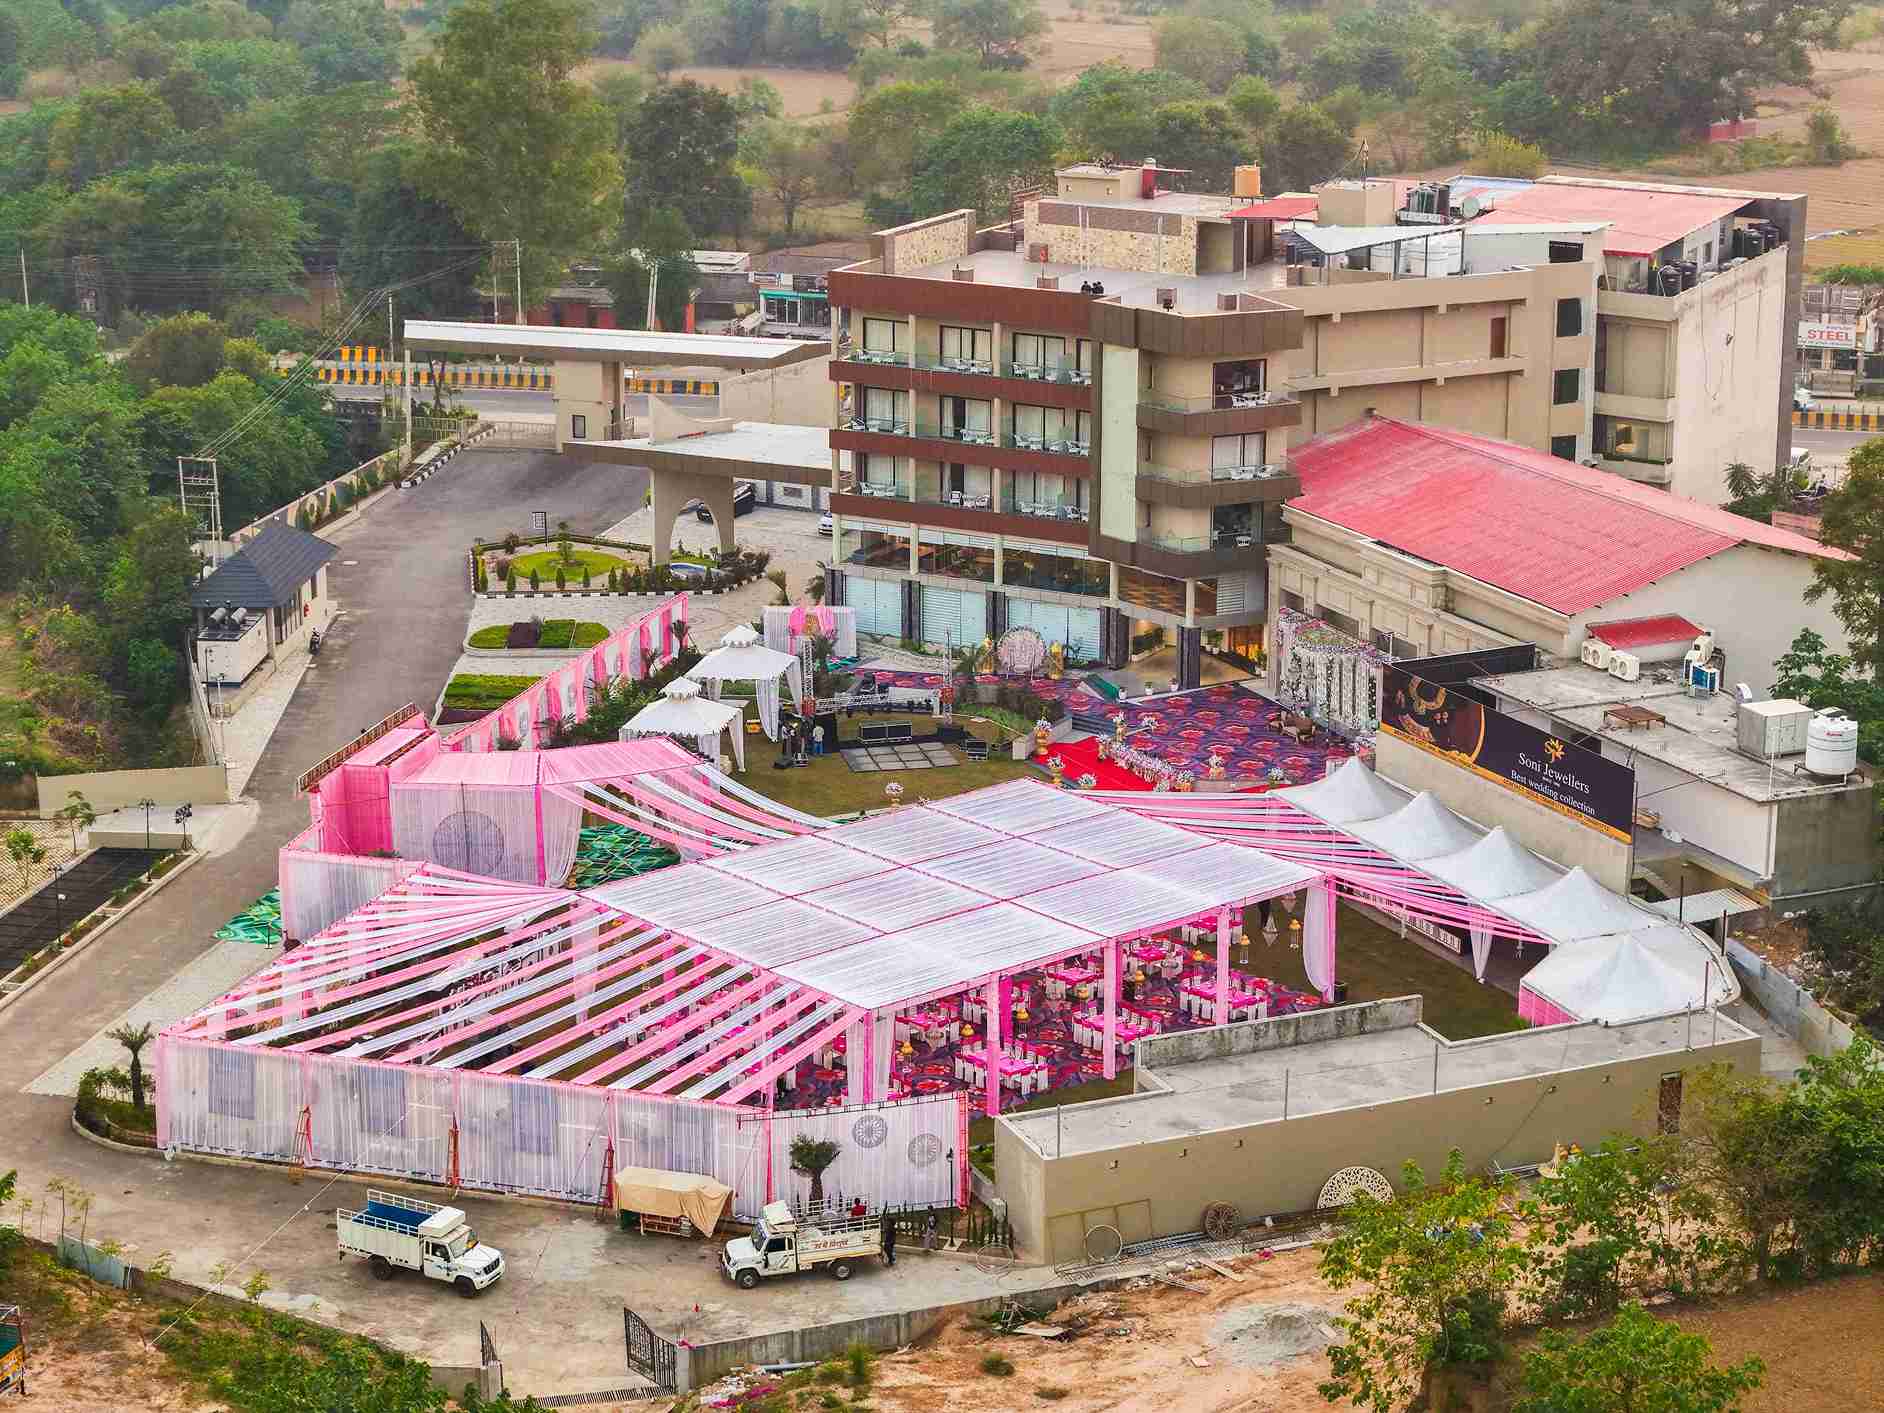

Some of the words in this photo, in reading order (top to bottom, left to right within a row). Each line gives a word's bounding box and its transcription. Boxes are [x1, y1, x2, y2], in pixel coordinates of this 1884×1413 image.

[1807, 329, 1851, 341] STEEL
[1511, 769, 1527, 784] Best
[1529, 779, 1558, 800] wedding
[1560, 794, 1595, 815] collection
[1519, 752, 1541, 772] Soni
[1543, 763, 1590, 794] Jewellers
